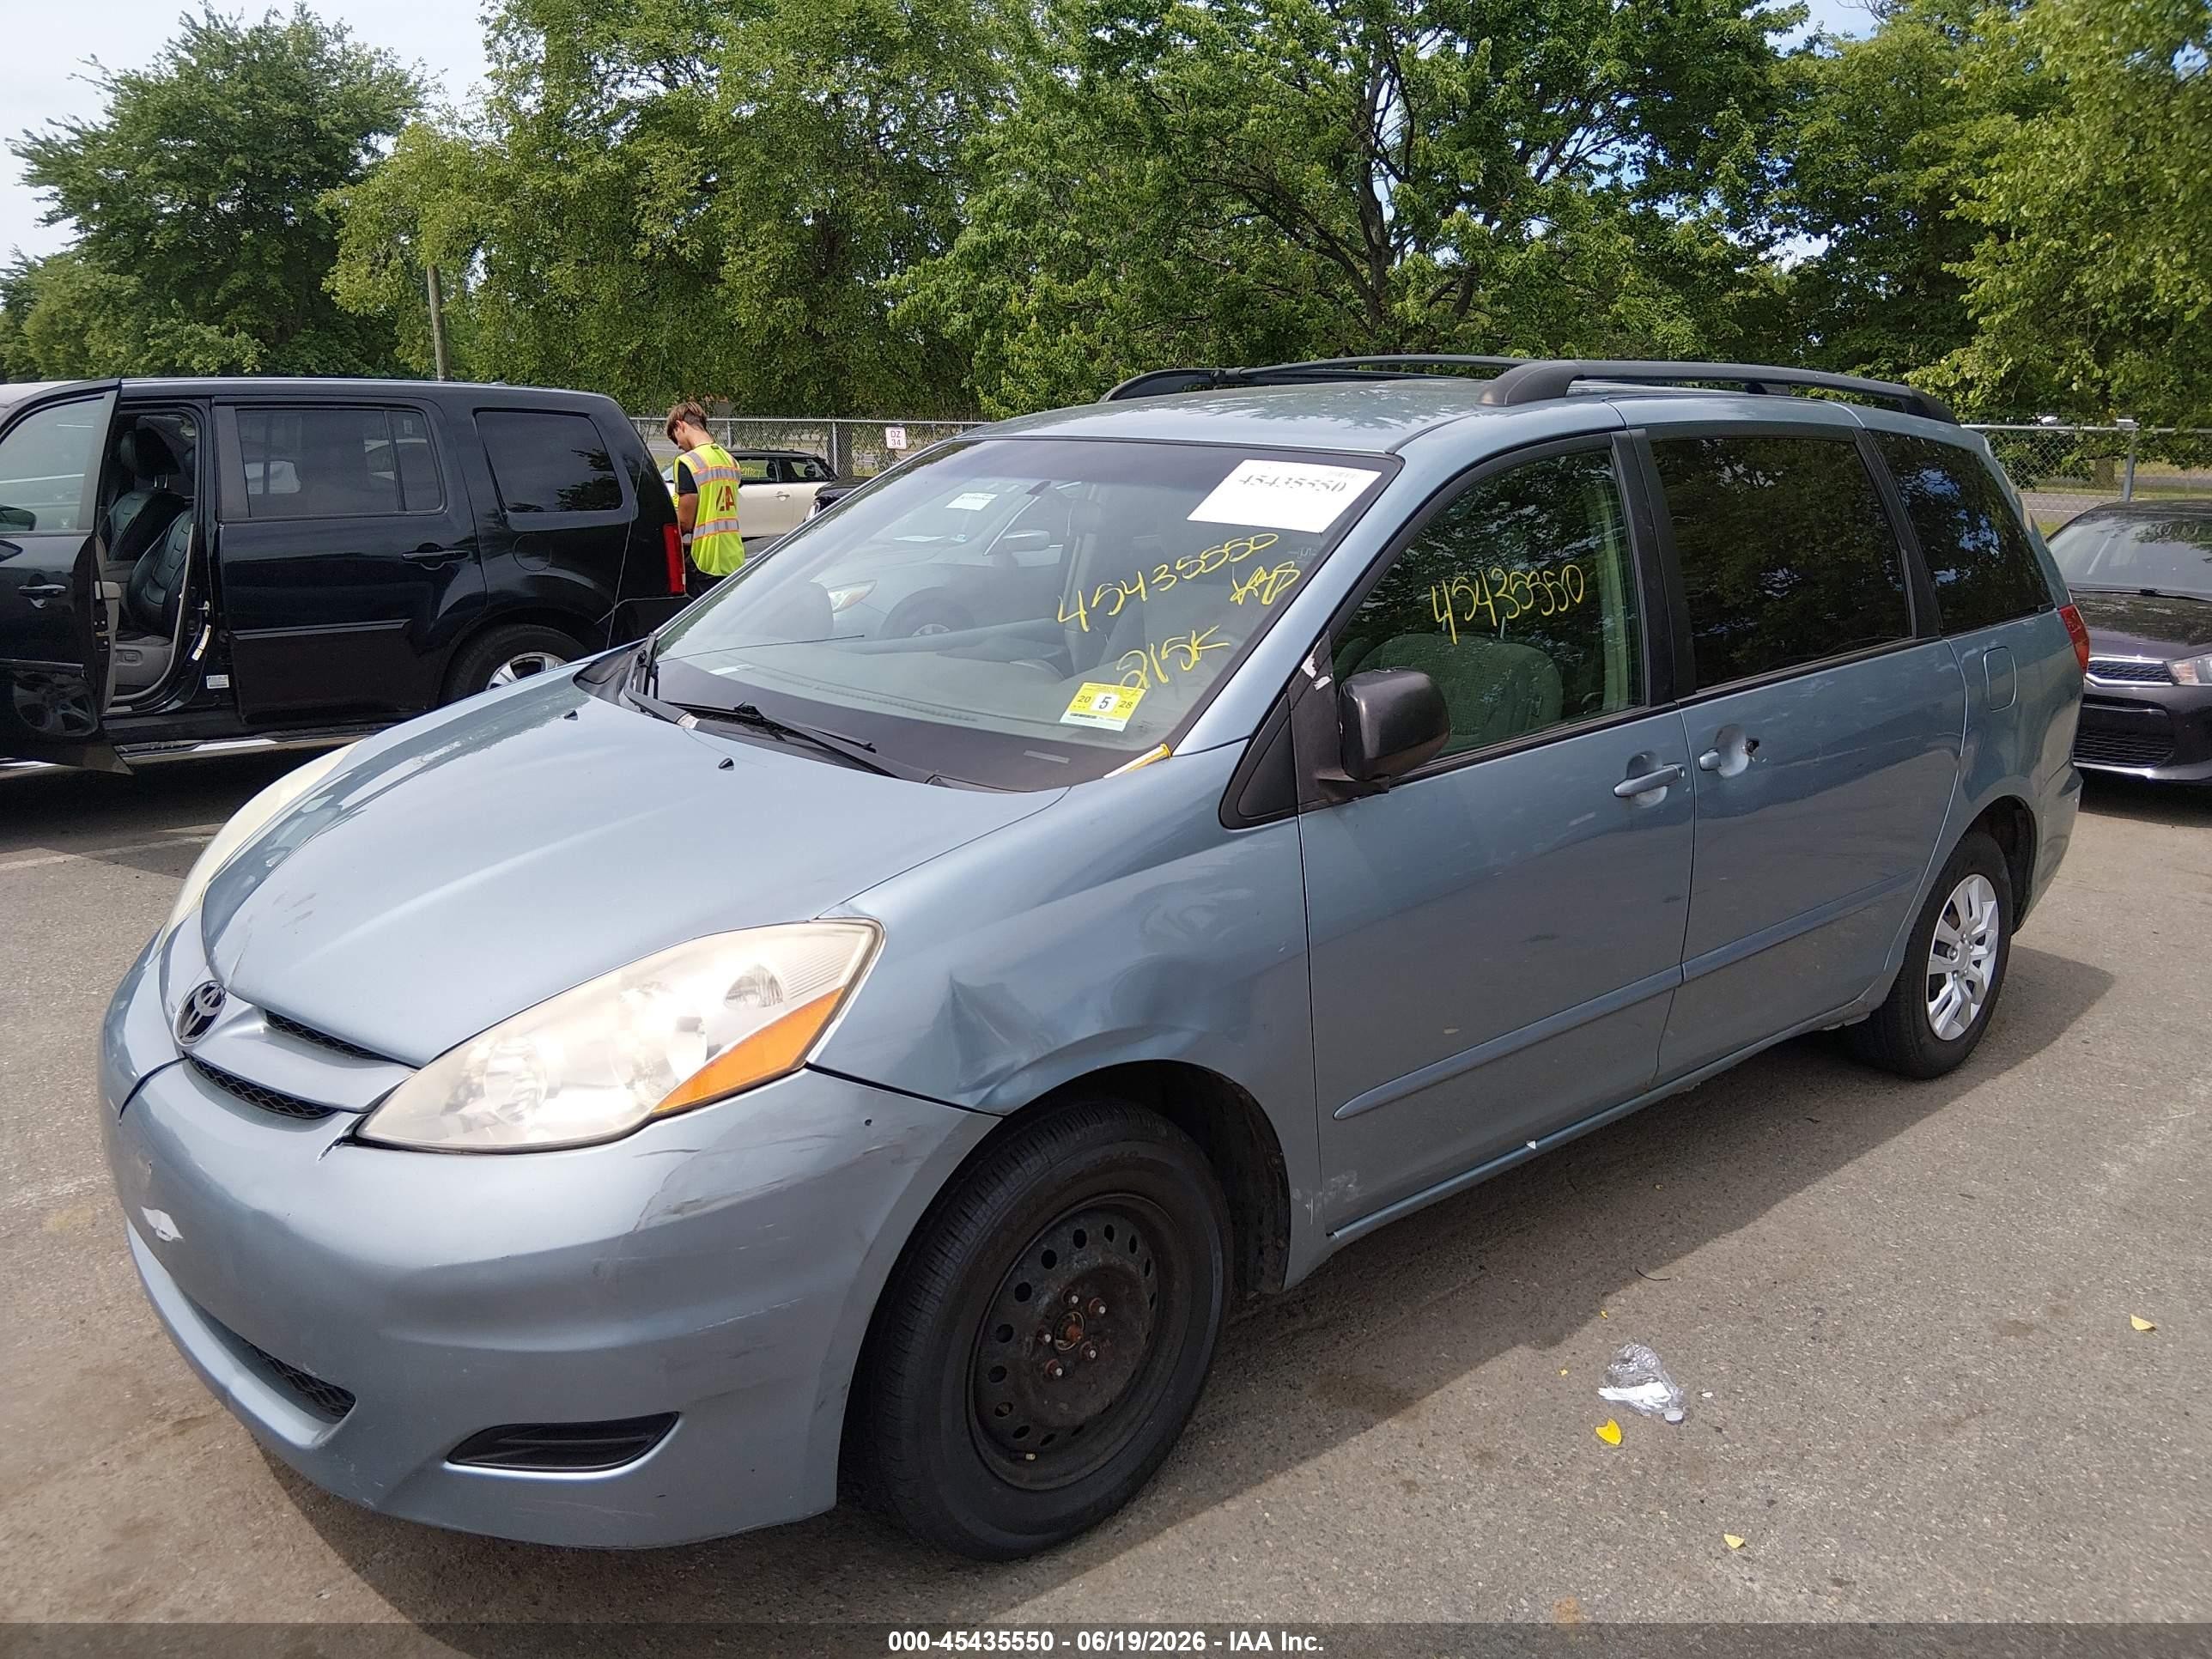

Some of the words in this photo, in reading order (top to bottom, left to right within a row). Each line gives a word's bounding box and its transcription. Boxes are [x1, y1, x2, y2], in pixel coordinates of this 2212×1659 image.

[1057, 533, 1279, 632] 45435550
[1431, 564, 1583, 645] 45435550
[1077, 695, 1091, 703] 20
[1098, 696, 1112, 709] 5
[1118, 700, 1133, 709] 28
